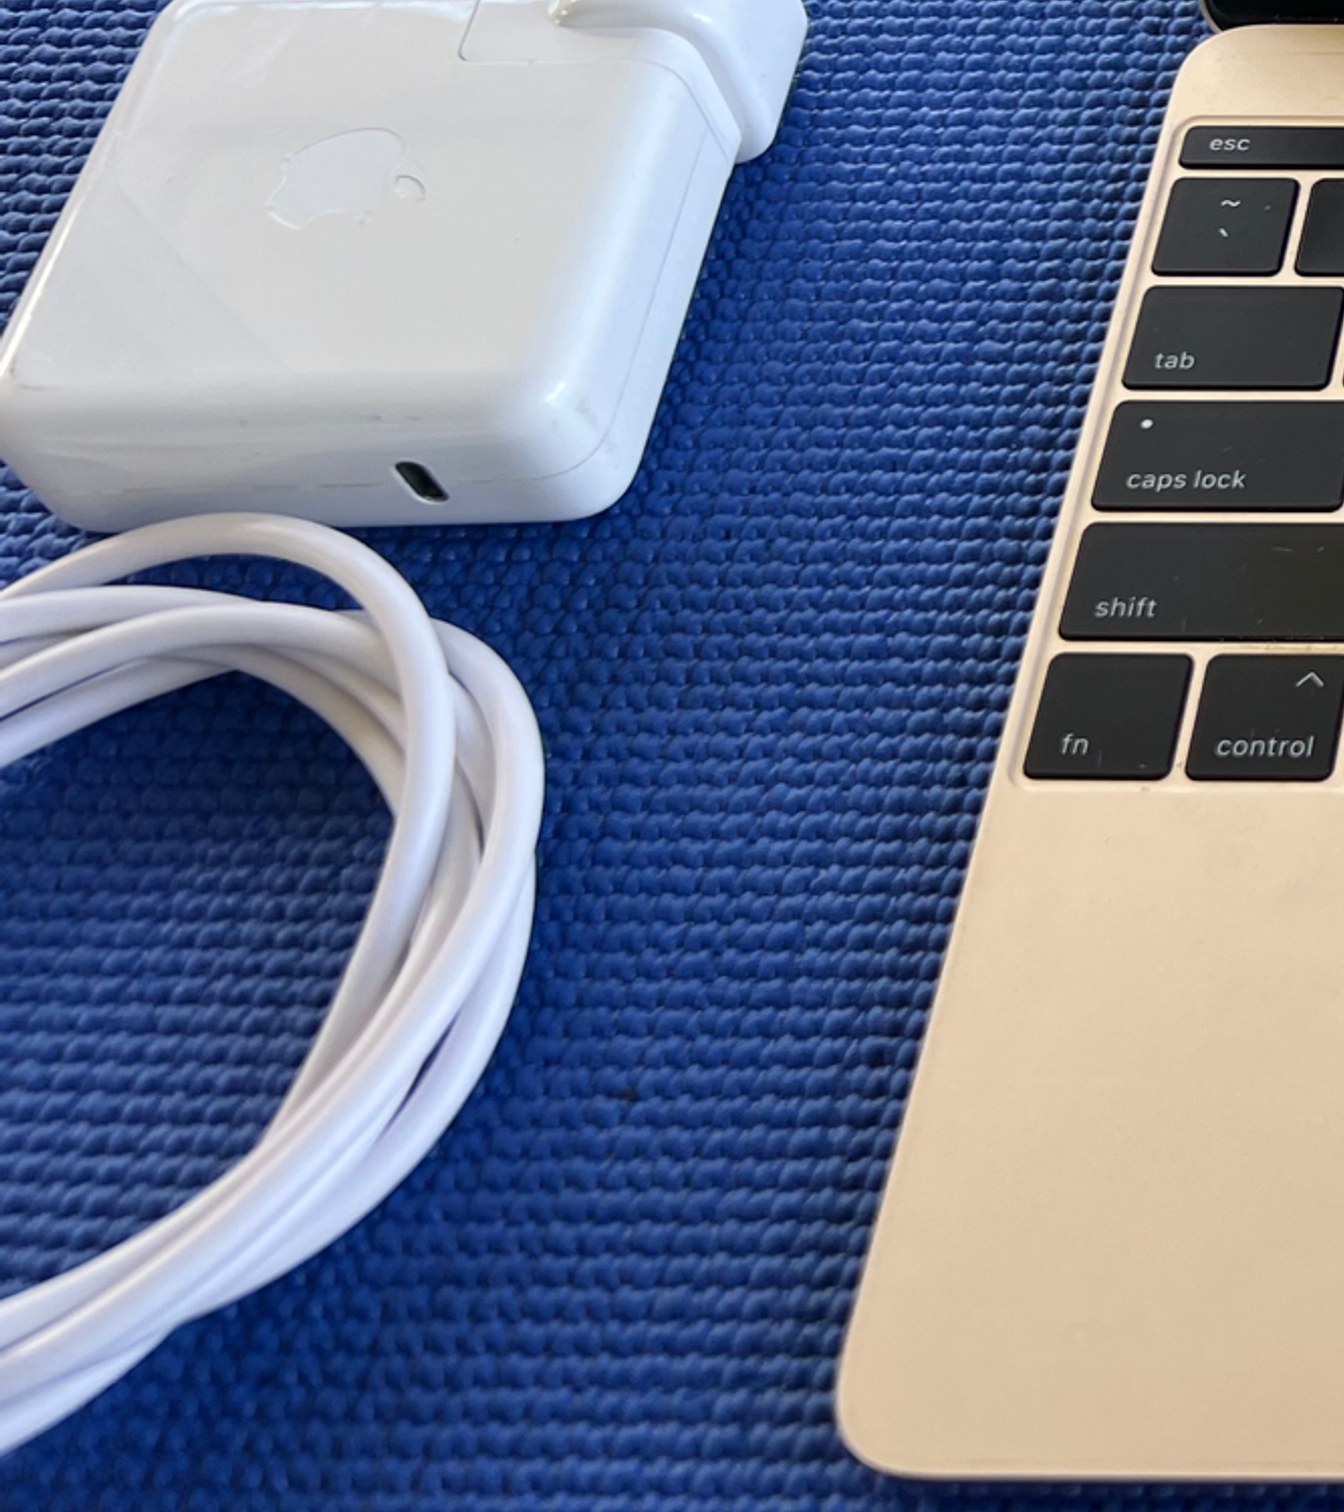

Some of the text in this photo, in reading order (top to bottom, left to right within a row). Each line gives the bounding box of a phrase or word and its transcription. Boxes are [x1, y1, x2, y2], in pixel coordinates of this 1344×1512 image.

[1209, 138, 1251, 151] esc
[1155, 351, 1195, 370] tab
[1126, 469, 1246, 493] caps lock
[1094, 596, 1157, 618] shift
[1061, 732, 1089, 755] fn
[1216, 735, 1315, 758] control
